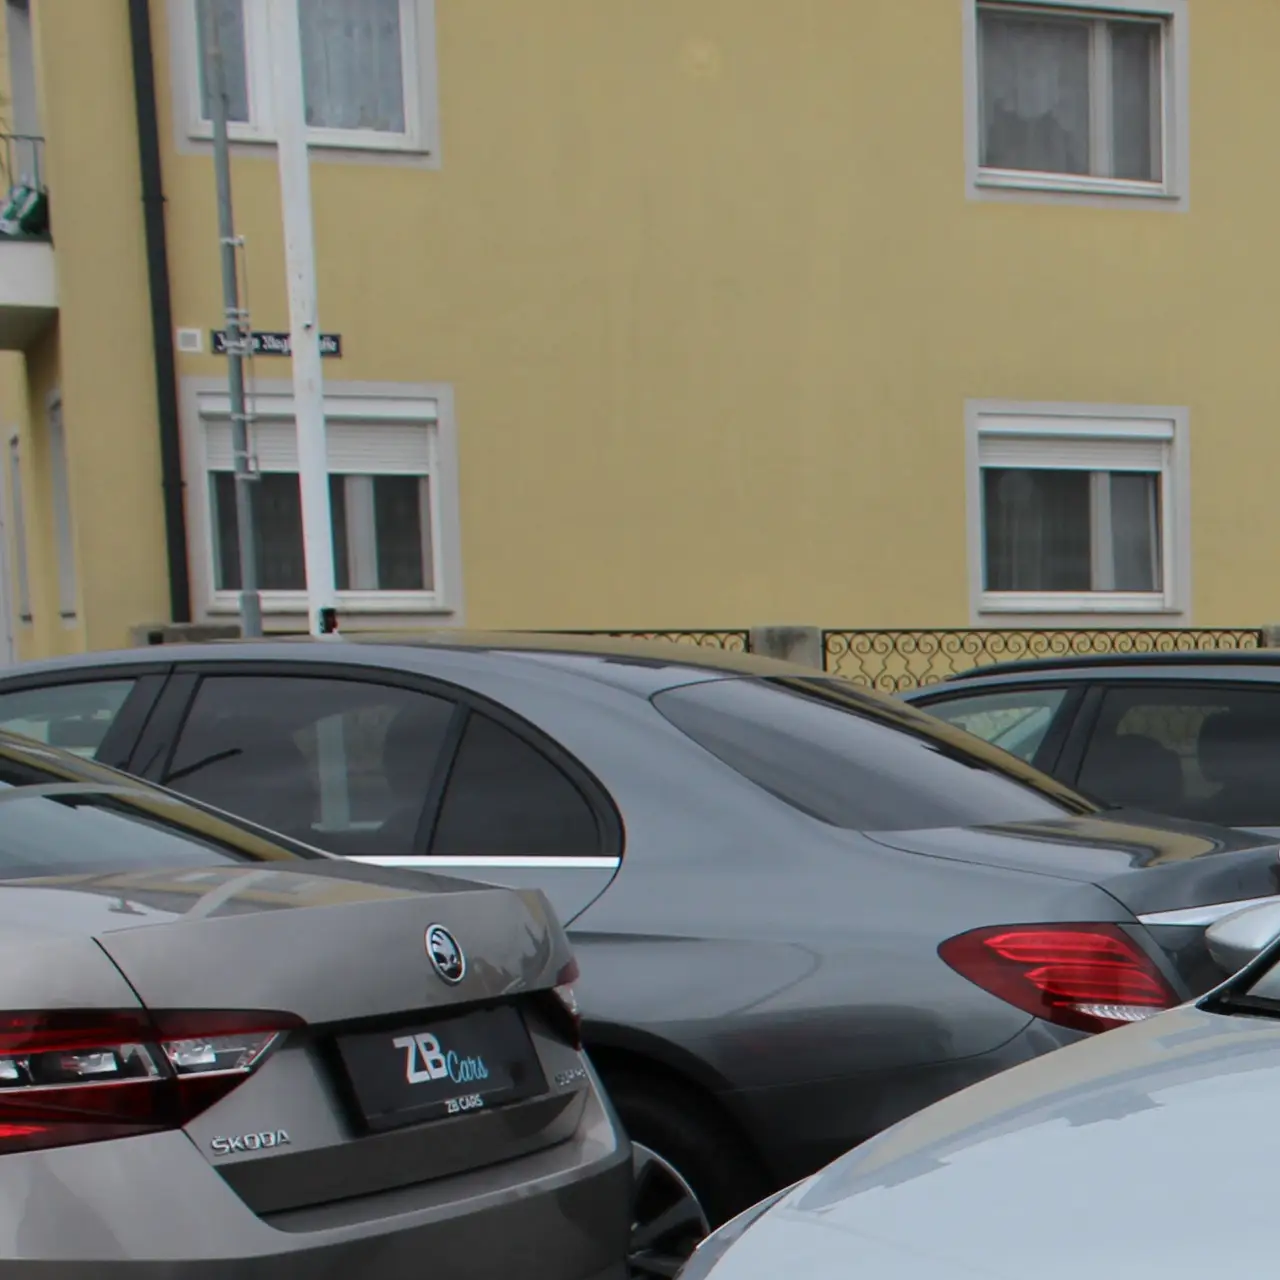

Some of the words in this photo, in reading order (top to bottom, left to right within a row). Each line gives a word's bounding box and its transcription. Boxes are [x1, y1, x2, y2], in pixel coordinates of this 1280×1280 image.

[392, 1032, 448, 1084] ZB
[446, 1050, 489, 1083] Cars
[444, 1099, 460, 1114] ZB
[459, 1094, 484, 1110] CARS
